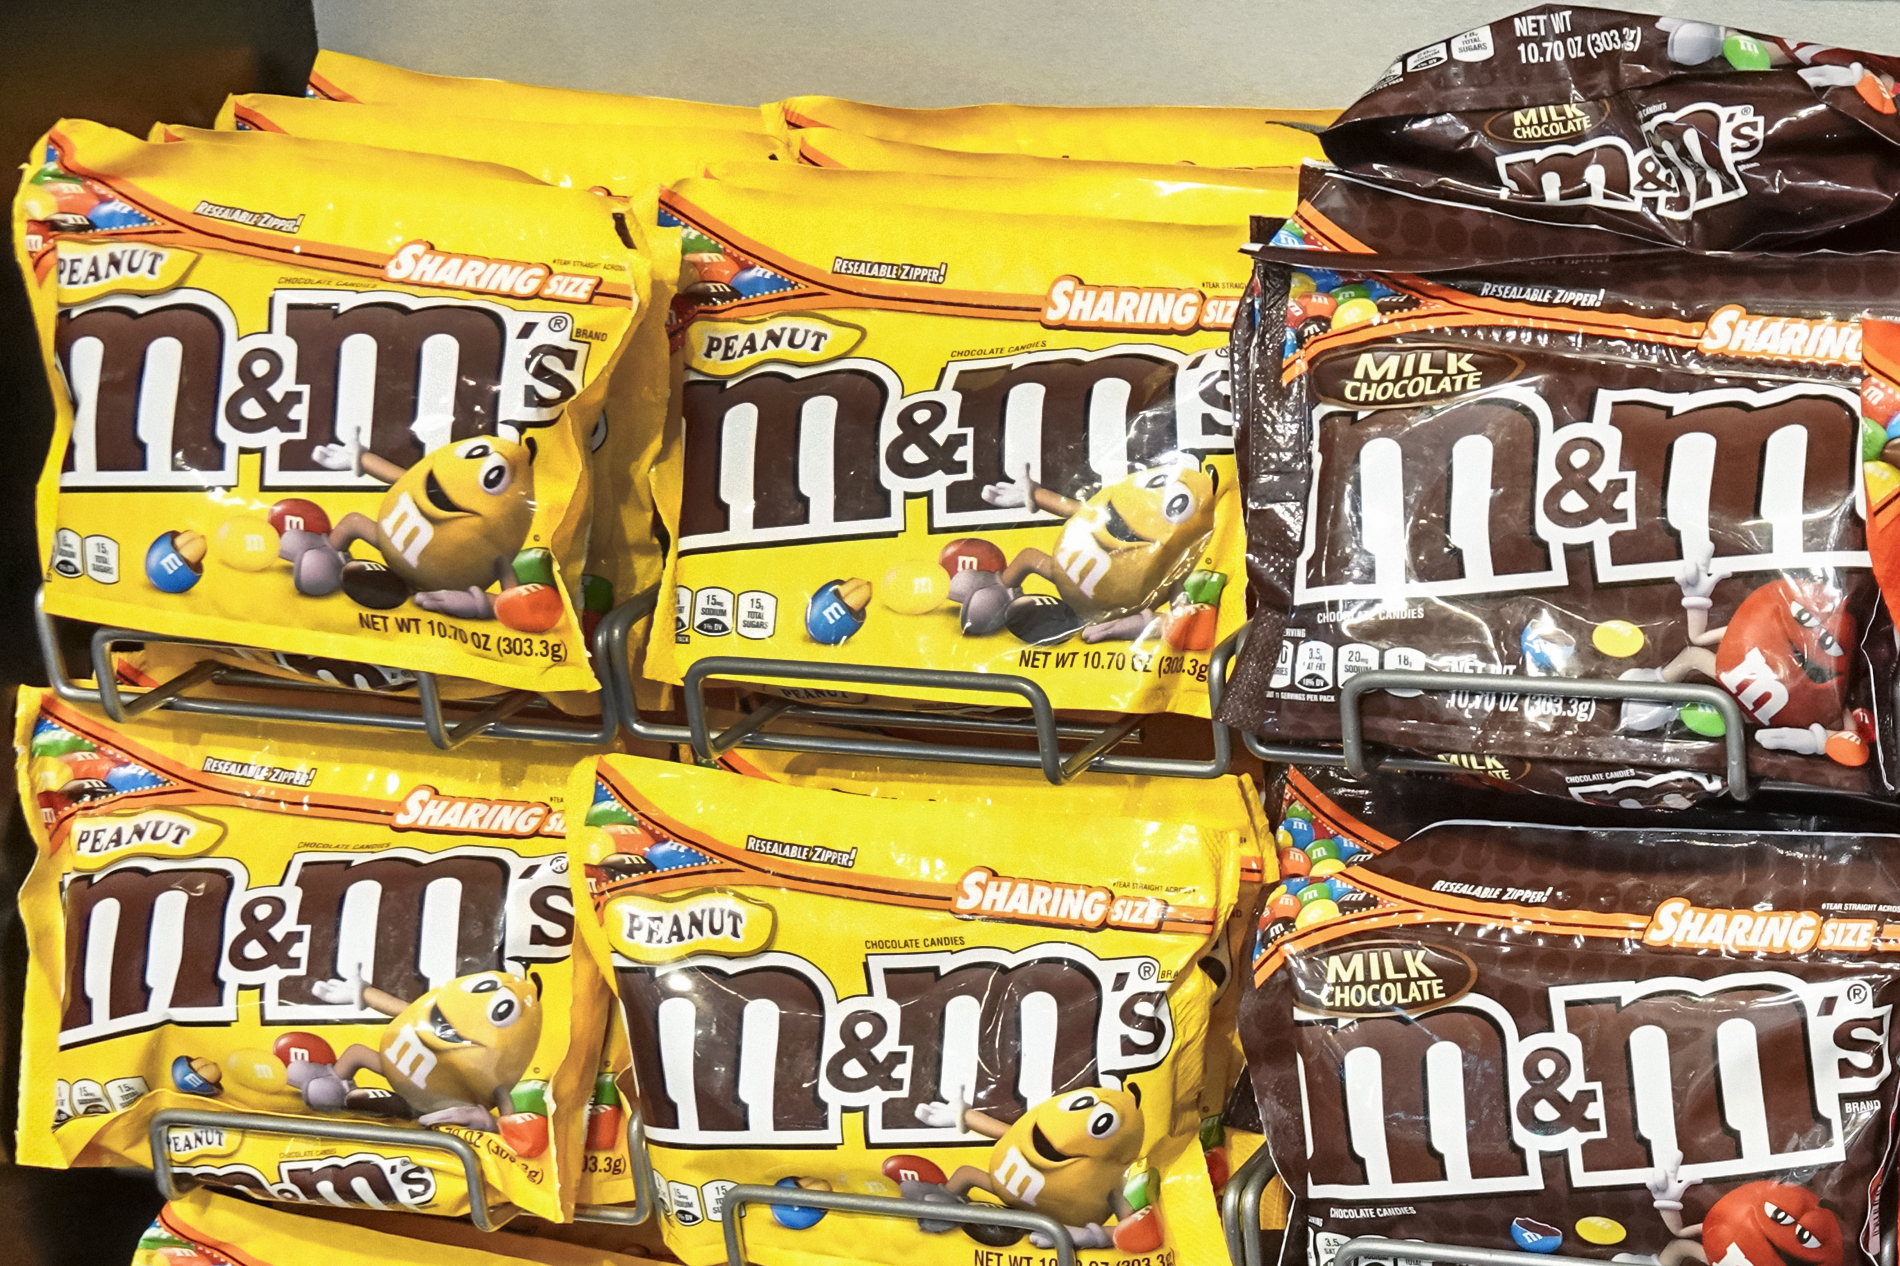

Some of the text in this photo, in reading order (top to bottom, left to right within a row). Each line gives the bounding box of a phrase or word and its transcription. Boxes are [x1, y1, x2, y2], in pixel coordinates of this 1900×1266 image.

[1514, 11, 1572, 38] NET WT
[1519, 36, 1584, 64] 10.70 OZ
[1512, 116, 1591, 139] CHOCOLATE
[1514, 104, 1582, 126] MILK
[195, 201, 304, 232] RESEALABLE ZIPPER!
[56, 249, 165, 287] PEANUT
[389, 244, 544, 296] SHARING
[544, 272, 598, 301] SIZE
[1047, 280, 1197, 326] SHARING
[704, 328, 827, 359] PEANUT
[1354, 353, 1476, 380] MILK
[1345, 372, 1482, 401] CHOCOLATE
[359, 613, 389, 631] NET
[395, 616, 422, 635] WT
[428, 620, 467, 644] 10.70
[472, 631, 492, 650] OZ
[1019, 650, 1126, 669] NET WT 10.70
[398, 788, 542, 832] SHARING
[76, 820, 190, 852] PEANUT
[955, 874, 1162, 925] SHARING SIZE
[1432, 880, 1552, 904] RESEALABLE ZIPPER!
[626, 912, 744, 944] PEANUT
[1650, 901, 1873, 948] SHARING SIZE
[1326, 949, 1436, 980] MILK
[1322, 979, 1446, 1003] CHOCOLATE
[1845, 1100, 1880, 1113] BRAND
